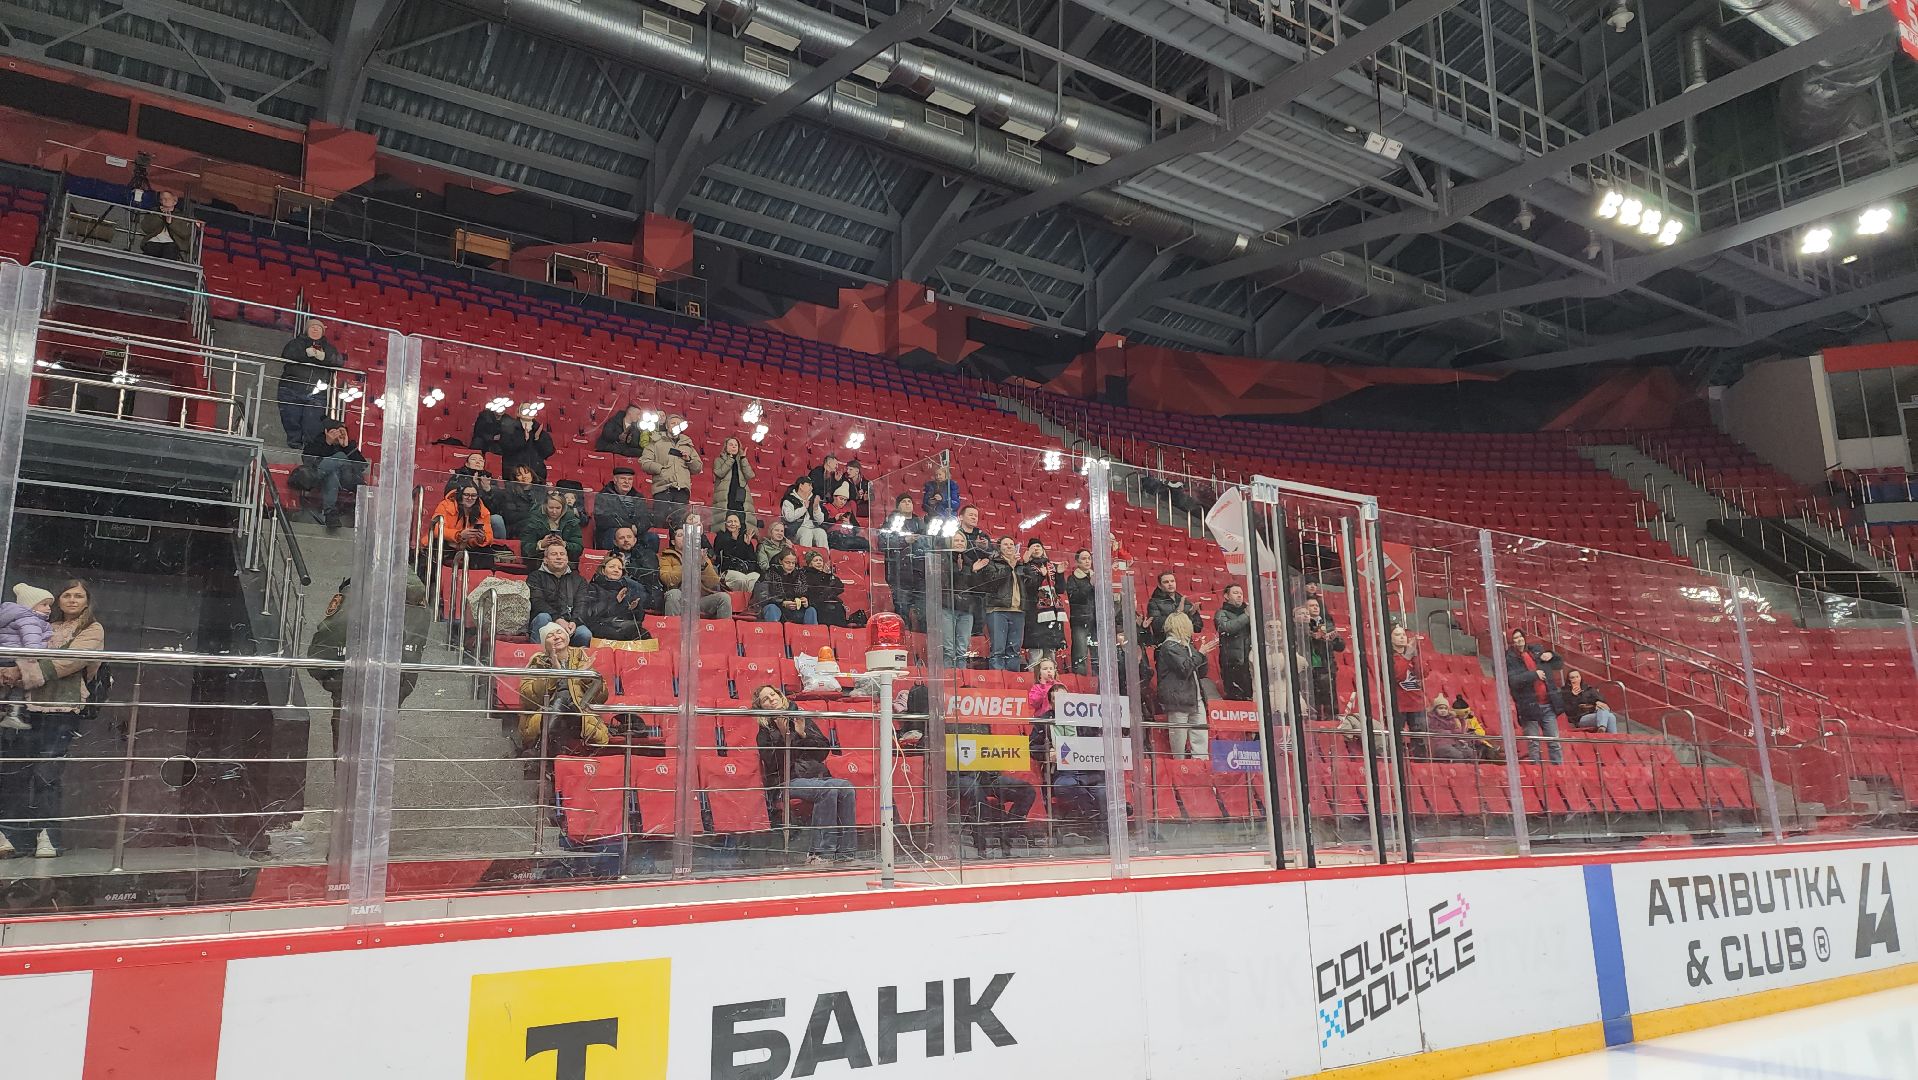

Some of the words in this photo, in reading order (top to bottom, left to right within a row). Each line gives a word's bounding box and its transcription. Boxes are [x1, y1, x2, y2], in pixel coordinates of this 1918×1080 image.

[947, 696, 1026, 716] FONBET
[1064, 701, 1122, 718] СОГ
[1210, 709, 1260, 721] OLIMPB
[980, 746, 1021, 758] БАНК
[1073, 751, 1129, 763] Ростелм
[111, 892, 137, 901] RAITA
[1648, 865, 1846, 927] ATRIBUTIKA
[1686, 939, 1714, 987] &
[1720, 926, 1807, 981] CLUB
[711, 972, 1018, 1080] БАНК
